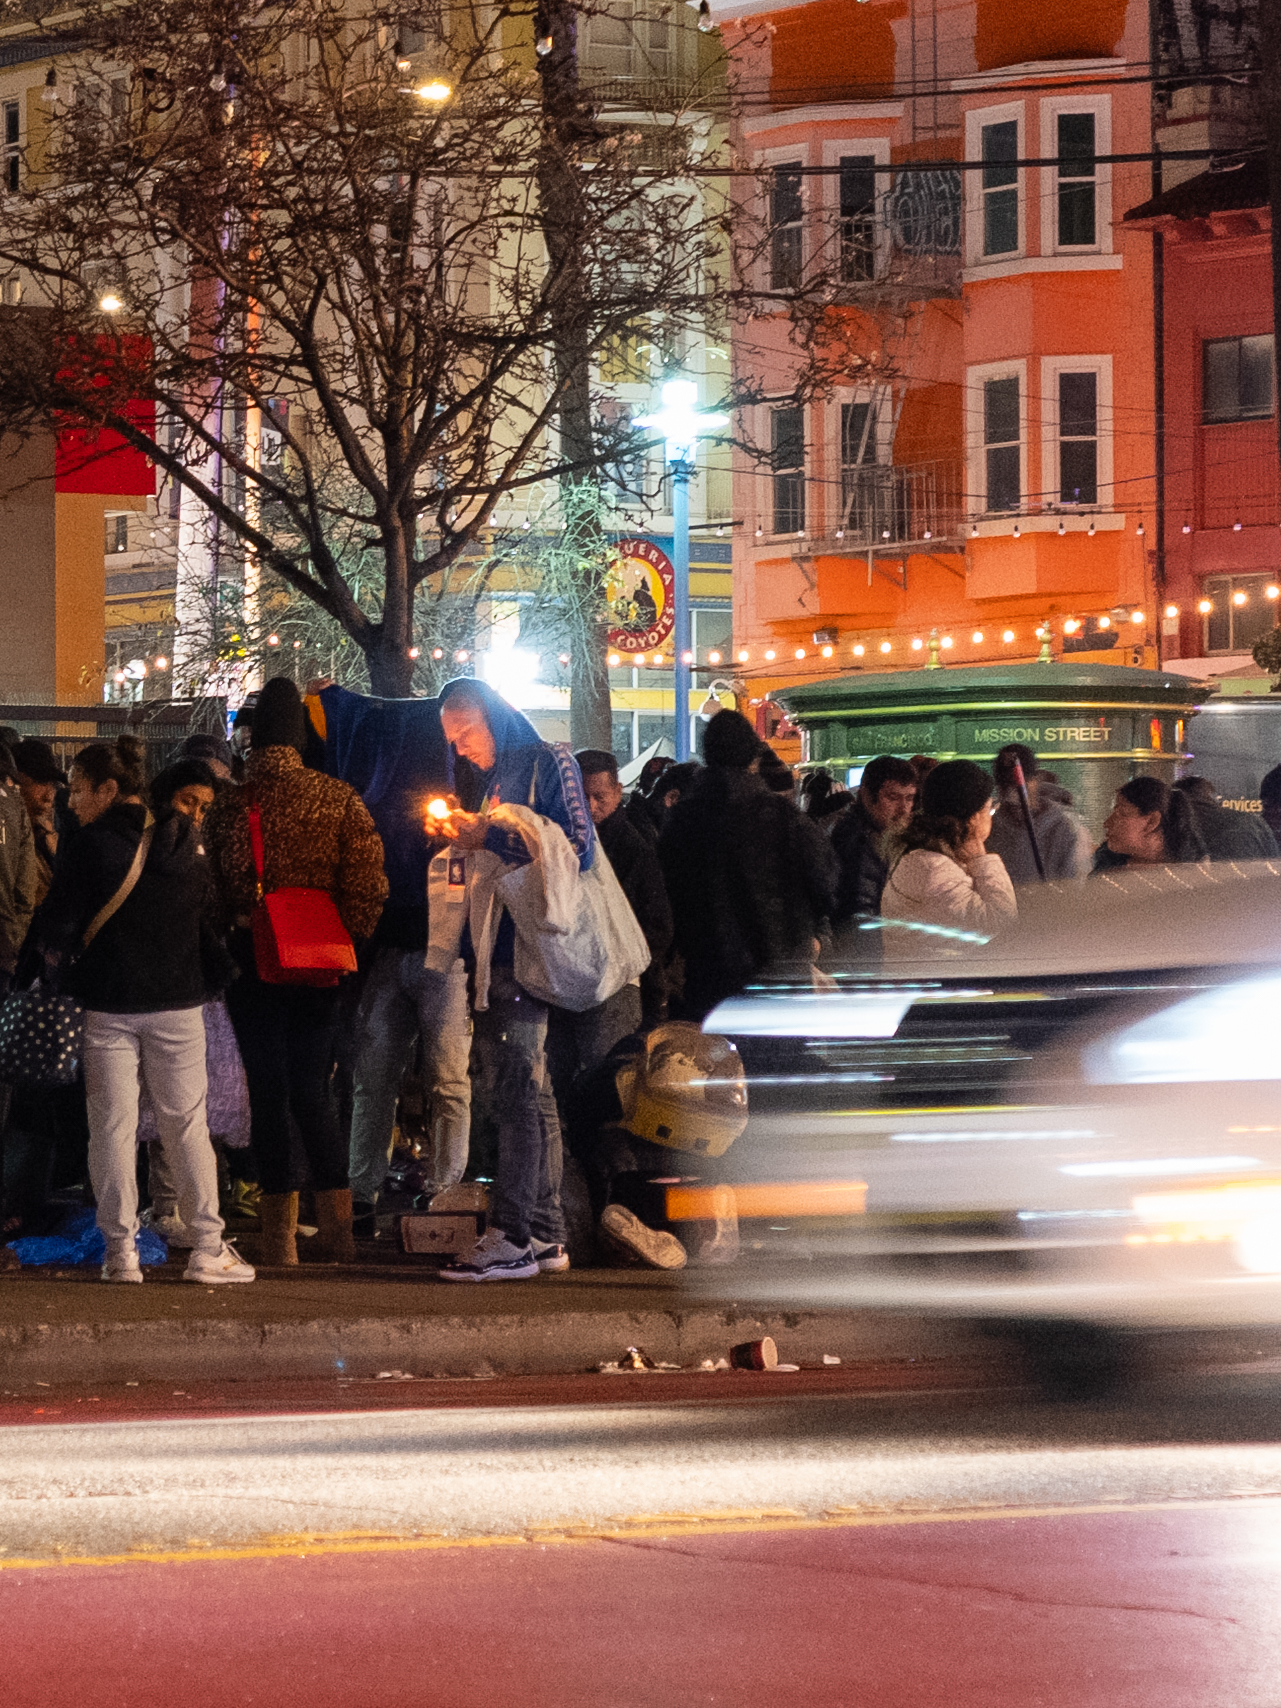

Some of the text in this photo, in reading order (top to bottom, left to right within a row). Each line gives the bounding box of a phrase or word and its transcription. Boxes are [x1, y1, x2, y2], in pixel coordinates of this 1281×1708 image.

[974, 727, 1112, 743] MISSION STREET
[1216, 795, 1264, 813] ervices
